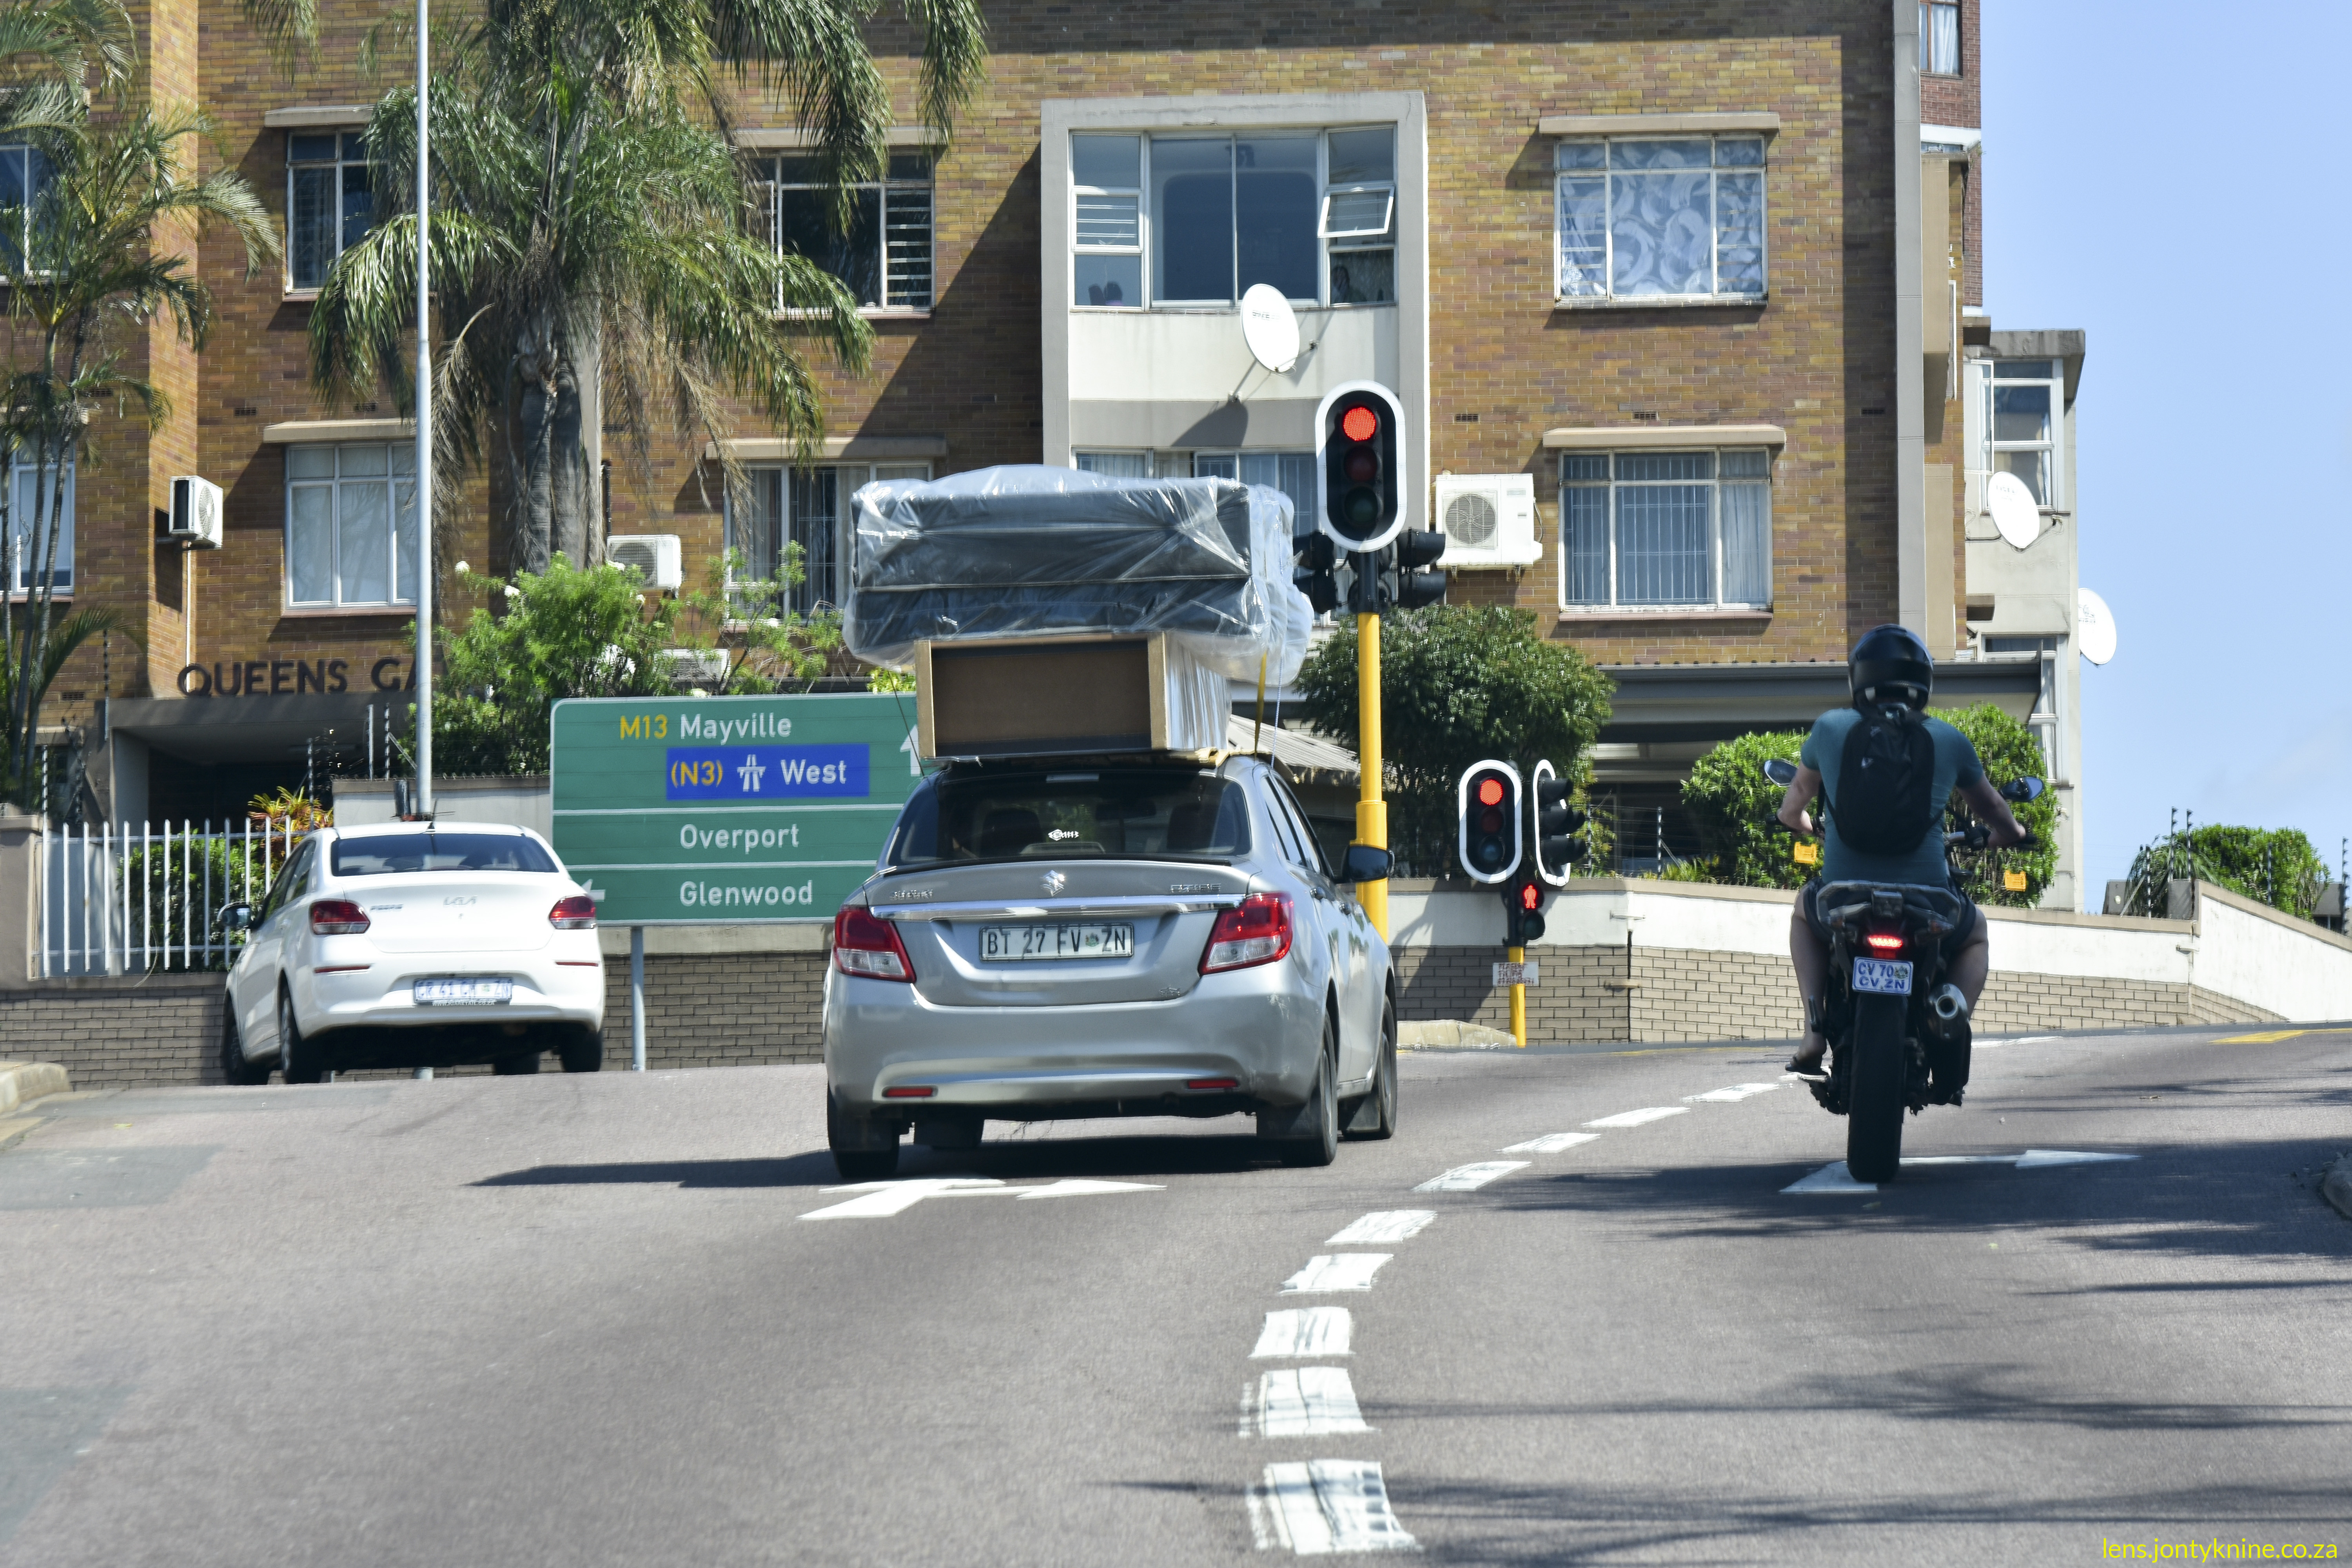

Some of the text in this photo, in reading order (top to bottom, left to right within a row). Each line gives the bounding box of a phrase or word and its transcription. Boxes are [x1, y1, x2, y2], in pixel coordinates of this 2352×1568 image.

[177, 659, 348, 696] QUEENS
[620, 712, 791, 745] M13 Mayville
[671, 759, 847, 788] (N3) West
[680, 824, 799, 854] Overport
[680, 879, 813, 907] Glenwood
[987, 927, 1126, 954] BT 27 FV ZN
[1858, 962, 1894, 977] CV 70
[1859, 976, 1905, 989] CV ZN
